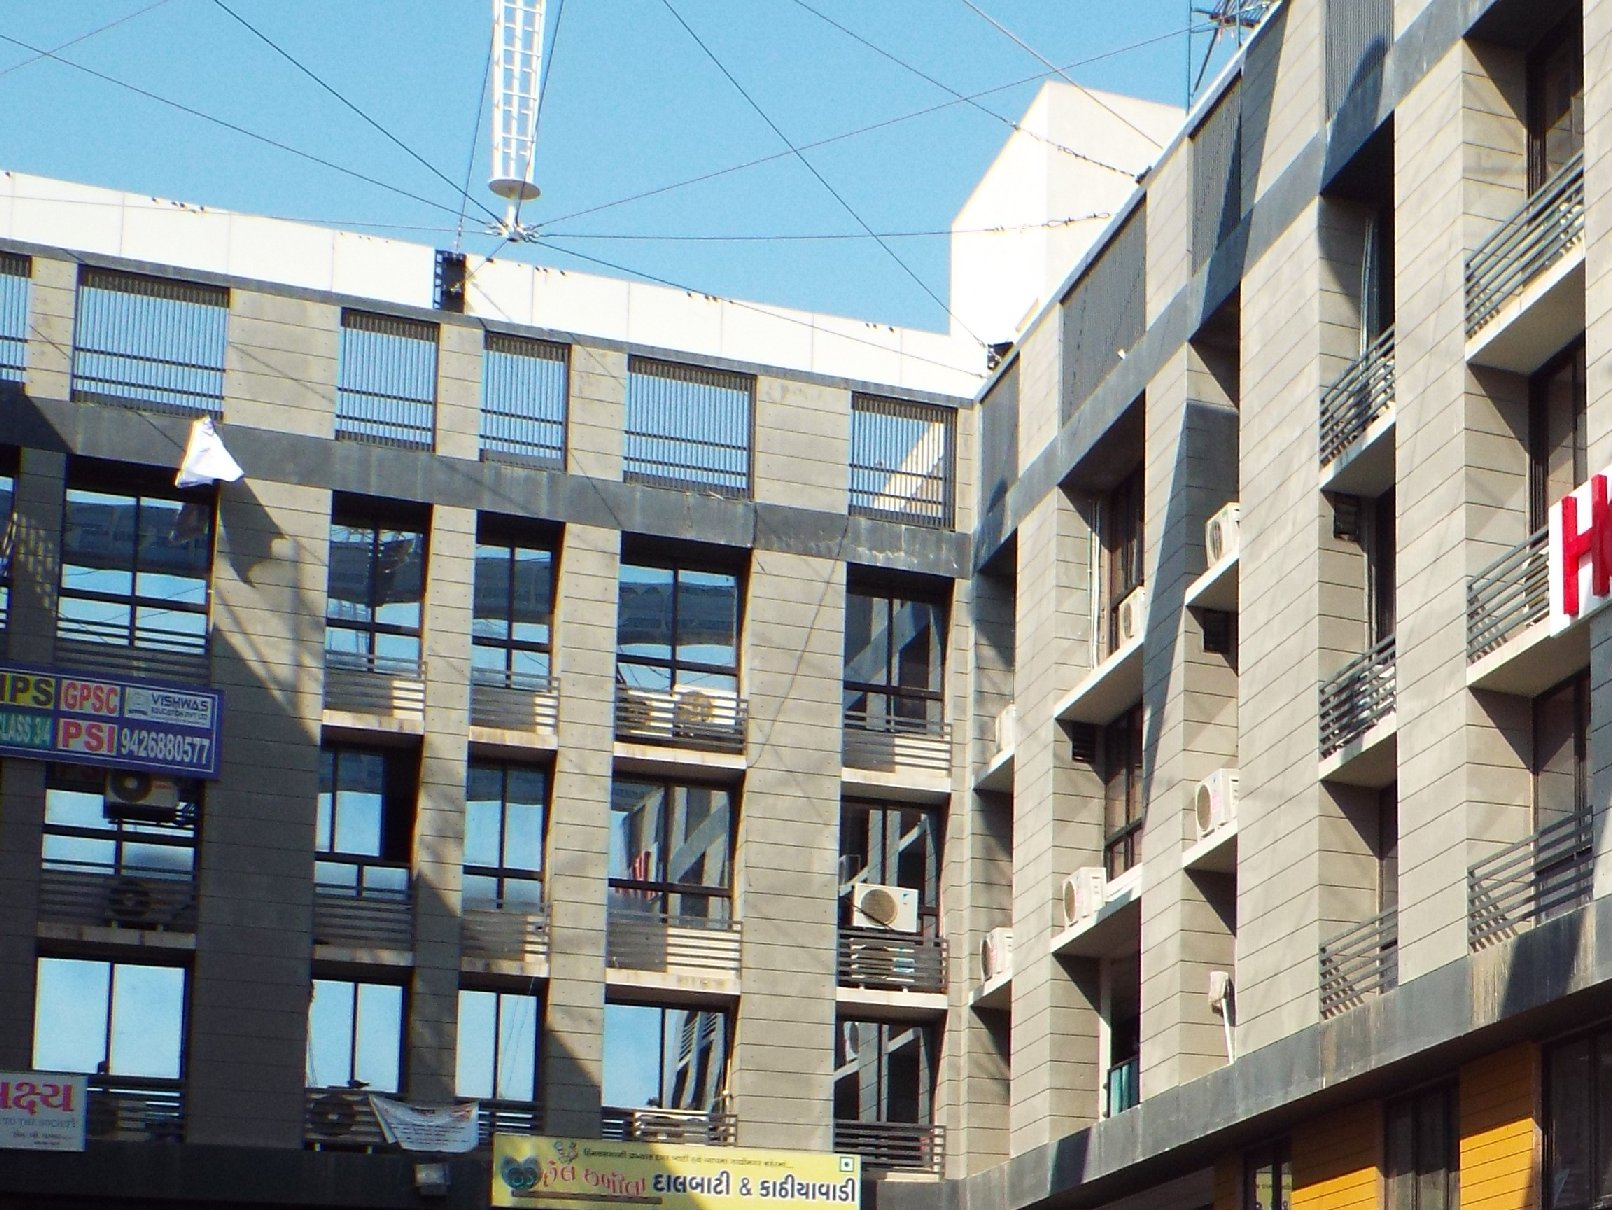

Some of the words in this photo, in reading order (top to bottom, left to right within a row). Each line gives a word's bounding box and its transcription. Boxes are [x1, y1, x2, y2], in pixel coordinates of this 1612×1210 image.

[63, 680, 119, 715] GPSC
[151, 692, 209, 712] VISHWAS
[0, 712, 31, 743] LASS
[61, 720, 116, 754] PSI
[121, 727, 211, 765] 9426880577
[653, 1170, 731, 1196] દાલબાટી
[739, 1177, 753, 1197] &
[759, 1173, 856, 1203] કાઠીયાવાડી
